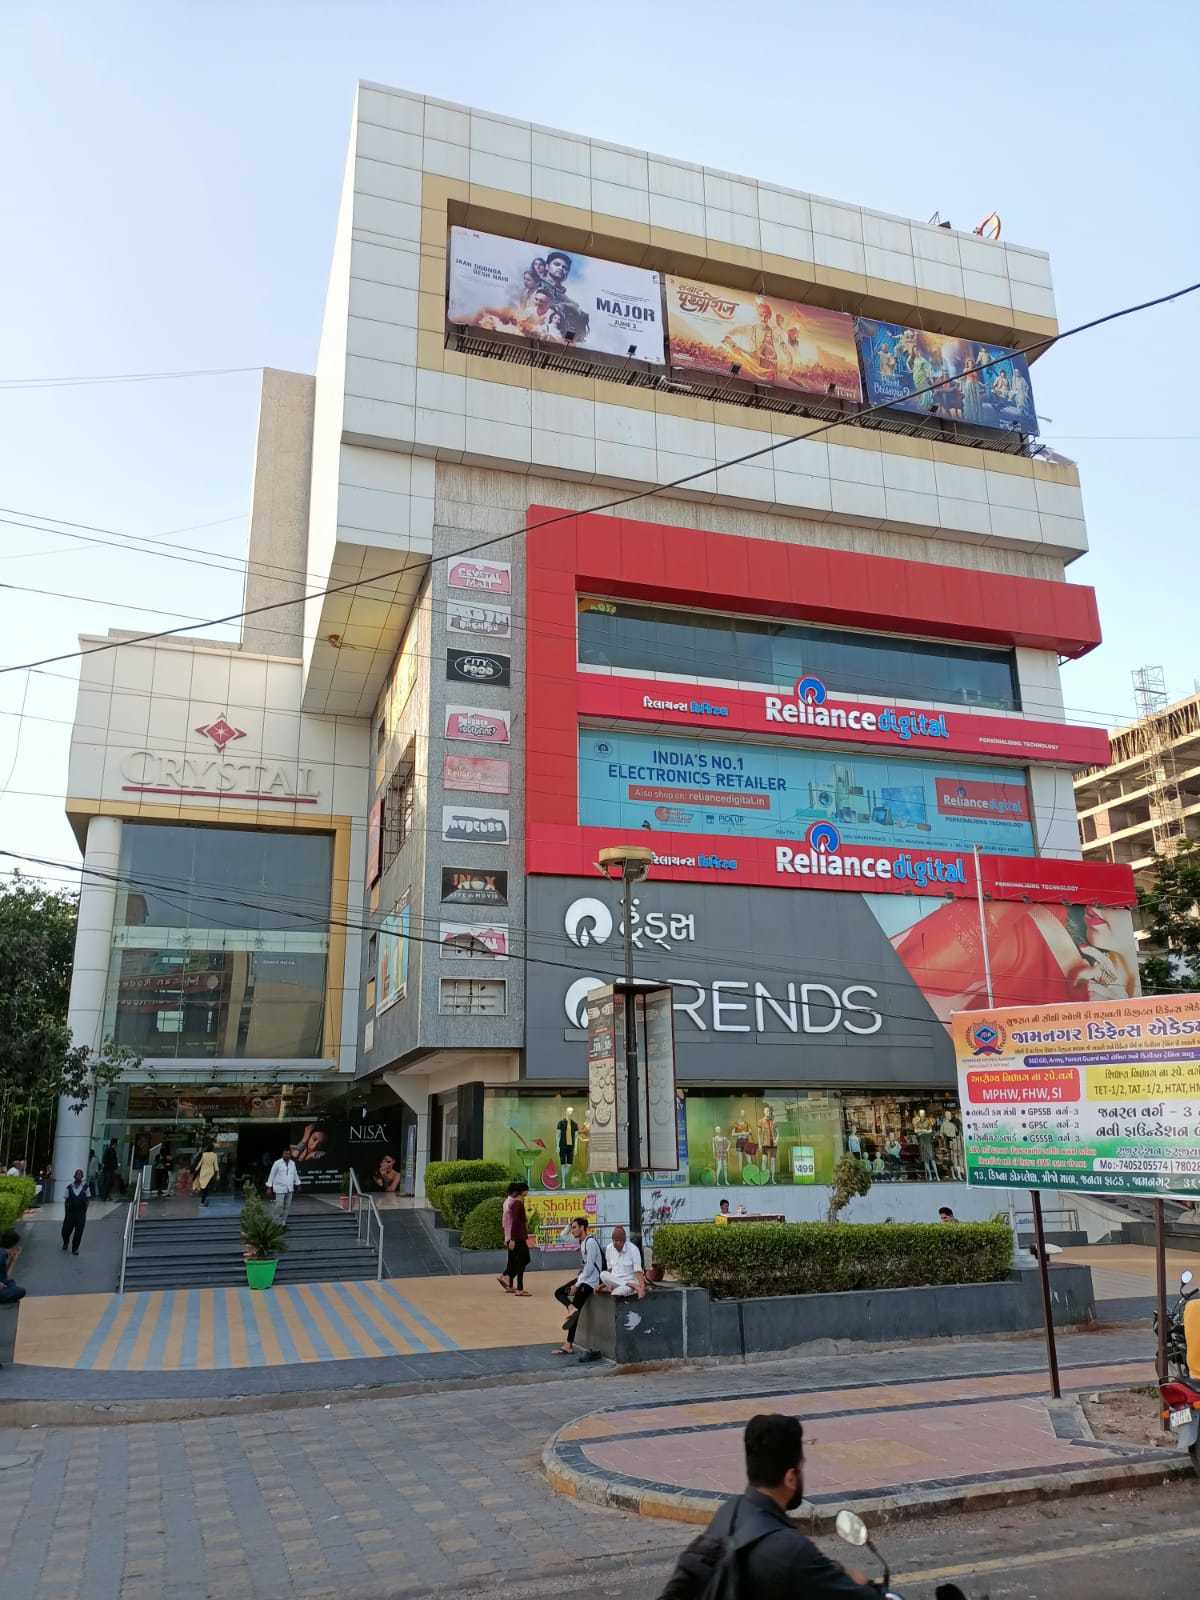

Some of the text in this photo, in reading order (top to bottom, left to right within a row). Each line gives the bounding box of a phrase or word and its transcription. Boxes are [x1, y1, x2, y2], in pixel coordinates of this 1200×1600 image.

[596, 297, 656, 322] MAJOR
[765, 697, 949, 740] Reliance digital
[653, 751, 744, 771] INDIA'S NO.1
[120, 752, 320, 798] CRYSTAL
[609, 765, 787, 791] ELECTRONICS RETAILER
[688, 793, 765, 807] reliancedigital.in
[943, 794, 989, 809] Reliance
[776, 846, 968, 887] Reliance digital
[453, 872, 497, 890] INOX
[1011, 1028, 1082, 1043] જામનગર
[1087, 1020, 1141, 1040] ડિફેન્સ
[983, 1087, 1062, 1101] MPHW, FHW, SI
[1027, 1108, 1052, 1116] GPSSB
[1098, 1106, 1137, 1119] જનરલ
[1141, 1103, 1166, 1117] વર્ગ
[350, 1124, 389, 1143] NISA
[1028, 1121, 1048, 1129] GPSC
[1096, 1122, 1120, 1137] નવી
